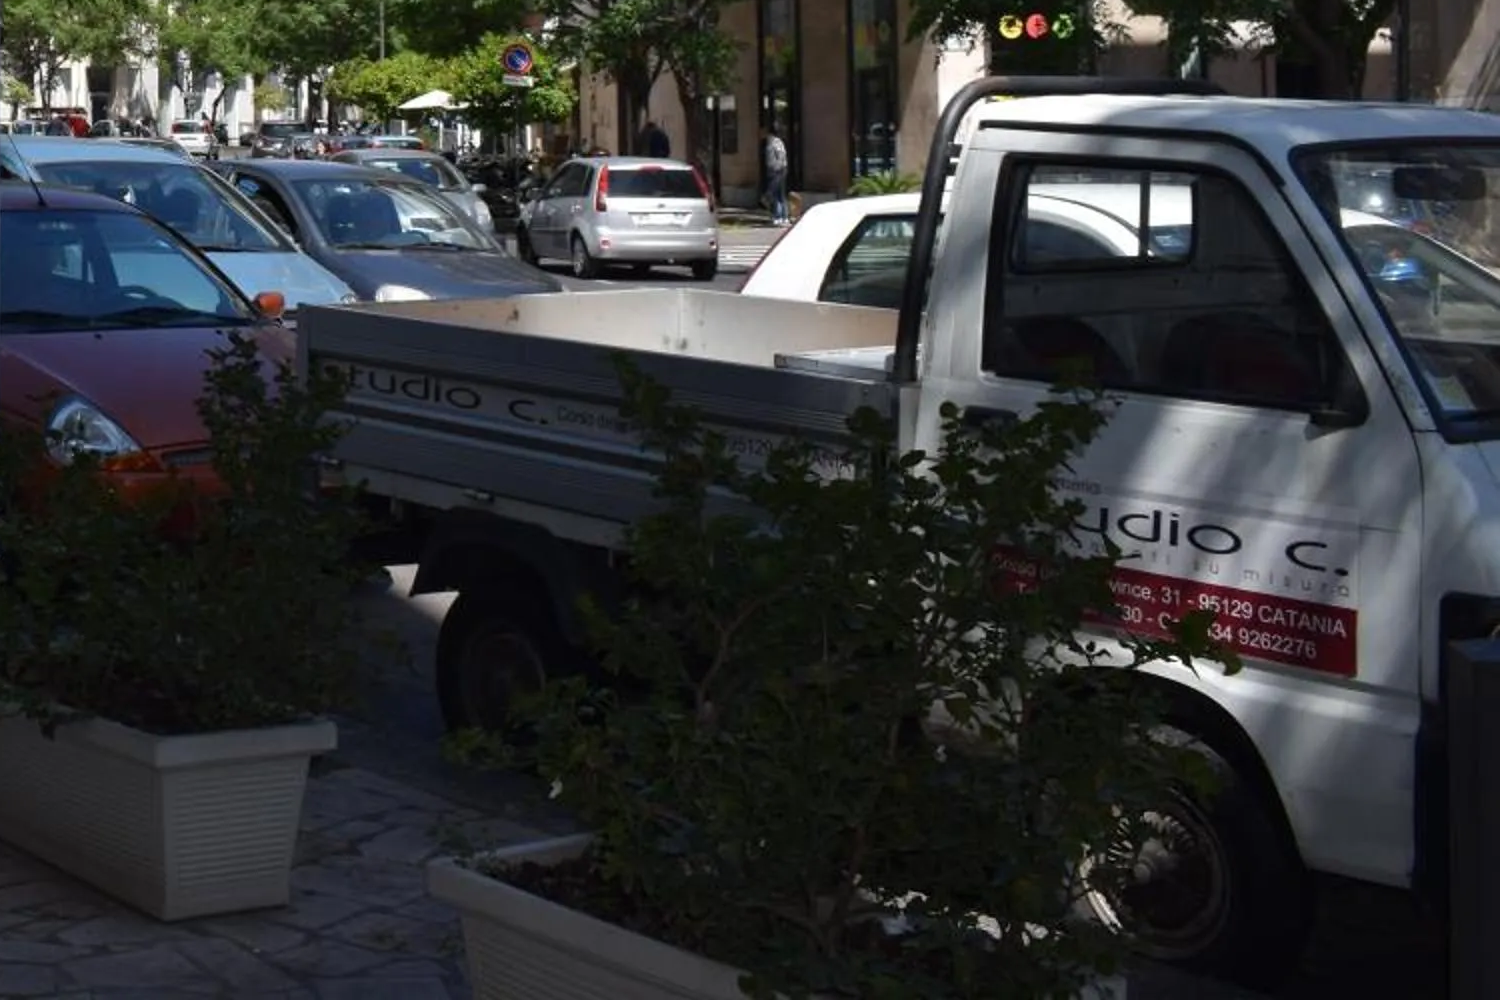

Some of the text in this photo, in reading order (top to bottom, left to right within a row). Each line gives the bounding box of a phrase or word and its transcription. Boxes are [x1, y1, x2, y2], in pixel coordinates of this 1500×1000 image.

[1160, 586, 1181, 607] 31
[1198, 593, 1254, 620] 95129
[1257, 605, 1347, 639] CATANIA
[1238, 627, 1318, 660] 9262276
